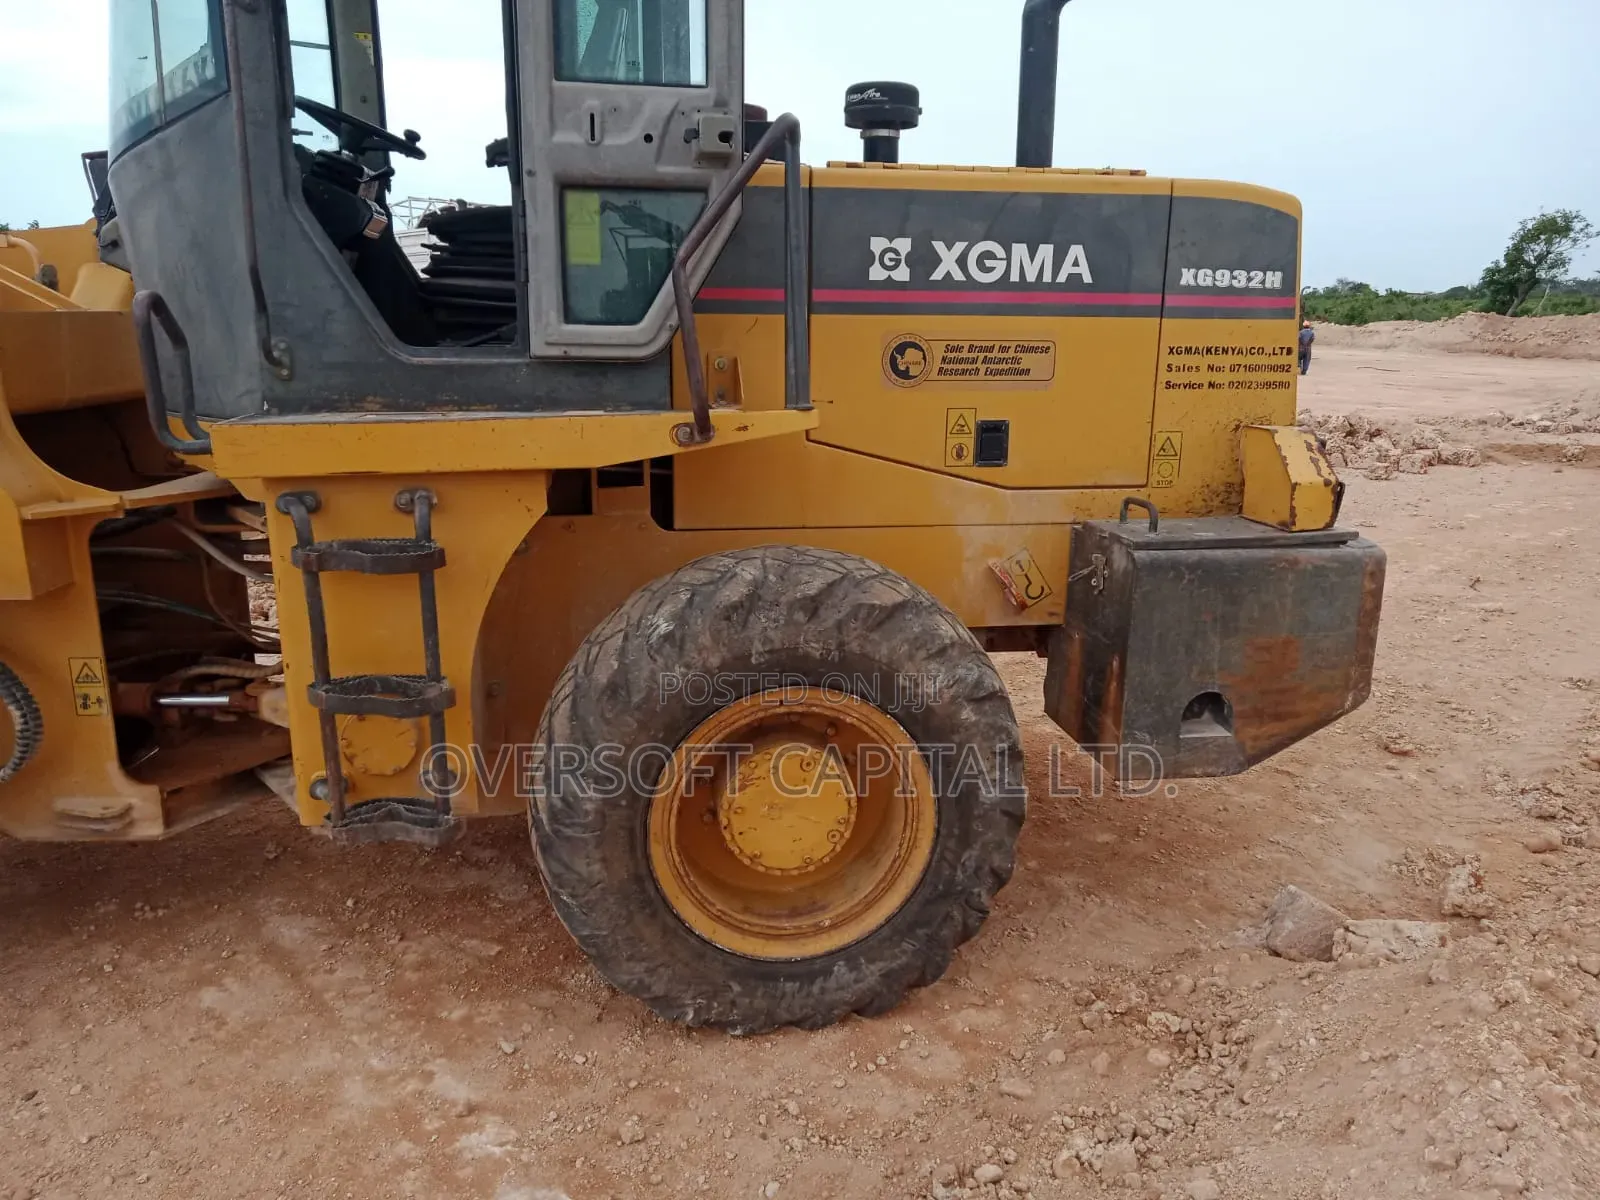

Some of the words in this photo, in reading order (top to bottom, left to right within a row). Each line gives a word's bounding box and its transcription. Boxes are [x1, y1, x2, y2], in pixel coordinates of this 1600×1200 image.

[929, 241, 1093, 284] XGMA
[1179, 268, 1283, 289] XG932H
[944, 344, 964, 354] Sole
[968, 344, 995, 354] Brand
[998, 344, 1011, 354] for
[1014, 344, 1051, 354] Chinese
[940, 355, 978, 365] National
[981, 355, 1023, 366] Antarctic
[937, 366, 981, 377] Research
[984, 366, 1031, 377] Expedition
[1166, 363, 1200, 373] Sales
[1207, 363, 1225, 373] No:
[1165, 380, 1204, 390] Service
[1208, 381, 1225, 390] No:
